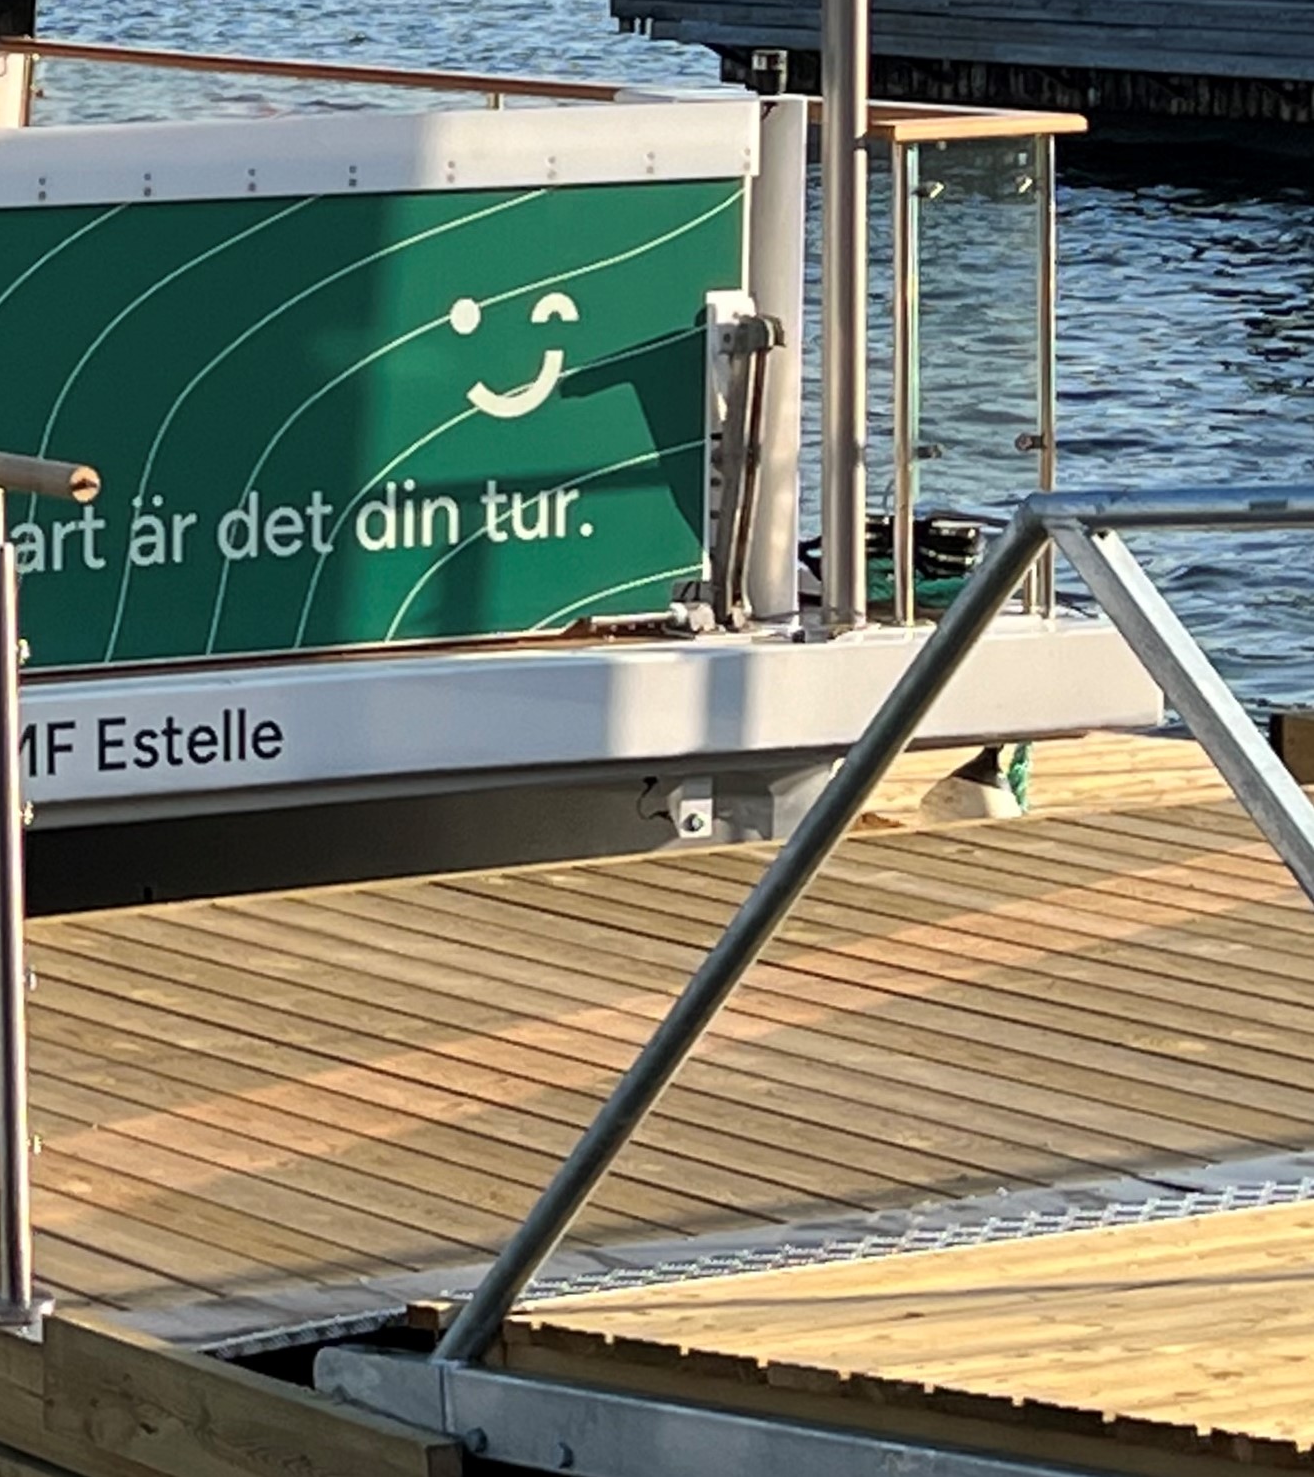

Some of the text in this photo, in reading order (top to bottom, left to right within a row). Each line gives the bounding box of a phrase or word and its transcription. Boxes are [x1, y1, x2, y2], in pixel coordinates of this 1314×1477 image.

[129, 495, 196, 566] är
[217, 490, 333, 560] det
[355, 479, 460, 551] din
[484, 478, 595, 543] tur.
[97, 708, 283, 772] Estelle
